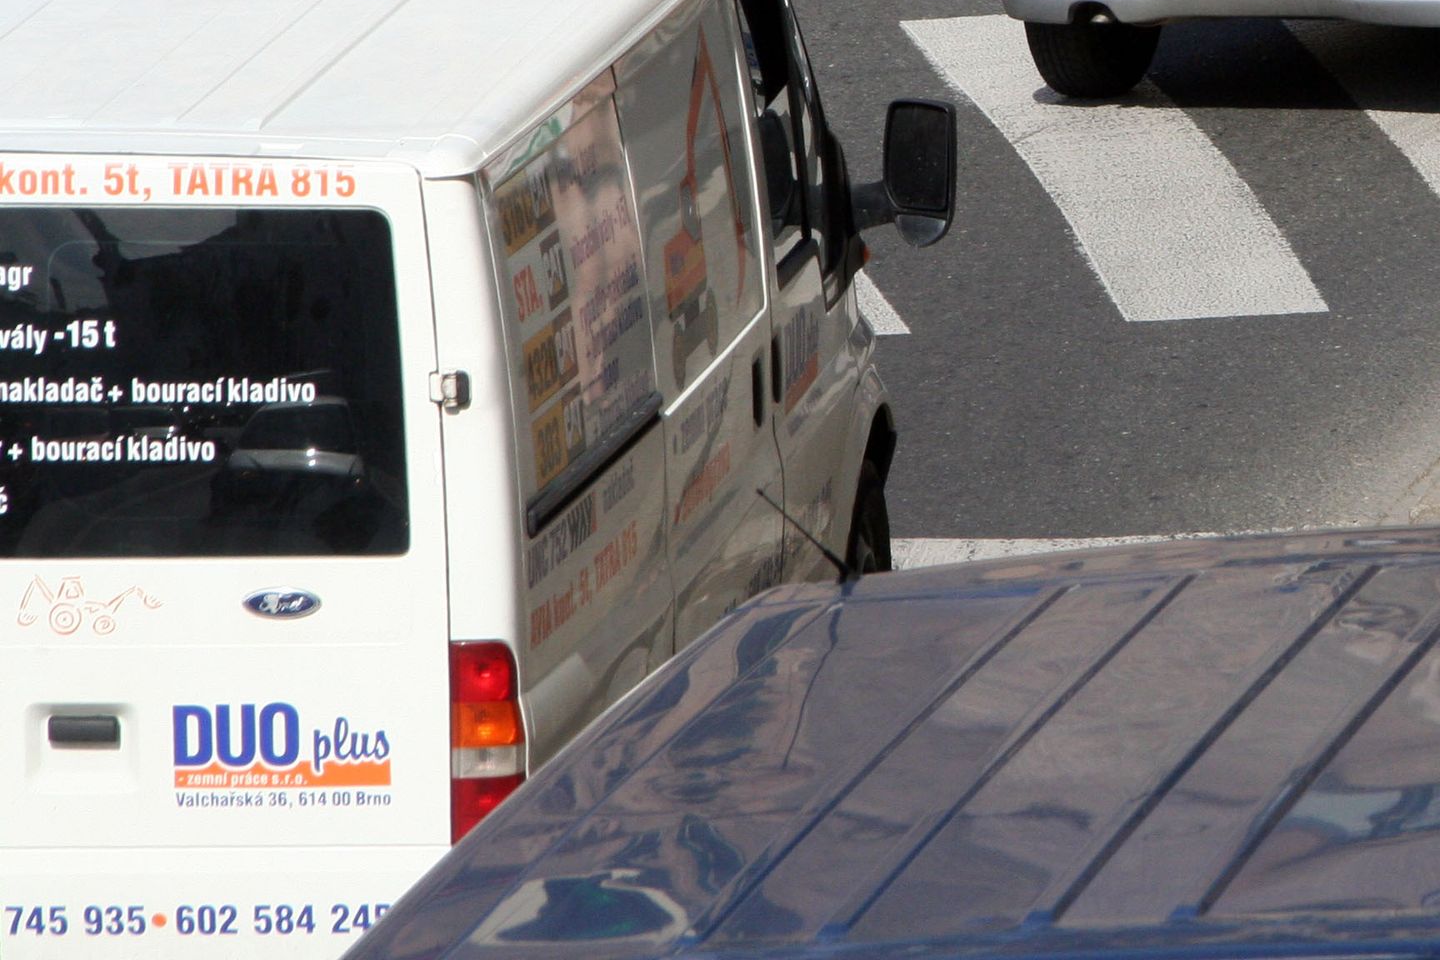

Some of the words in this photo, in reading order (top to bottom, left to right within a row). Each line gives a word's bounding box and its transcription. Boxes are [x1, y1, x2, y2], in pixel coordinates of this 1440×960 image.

[104, 163, 151, 201] 5t,
[168, 163, 278, 197] TATRA
[292, 164, 355, 197] 815
[132, 377, 222, 403] bourací
[228, 377, 315, 403] kladivo
[31, 435, 122, 461] bourací
[127, 435, 215, 461] kladivo
[173, 702, 299, 767] DUO
[313, 717, 390, 772] plus
[187, 771, 228, 786] zemní
[230, 771, 268, 788] práce
[271, 772, 308, 786] s.r.o.
[176, 791, 263, 808] Valchařská
[268, 792, 294, 809] 36,
[299, 791, 327, 807] 614
[332, 791, 351, 807] 00
[356, 791, 392, 807] Brno
[5, 905, 68, 936] 745
[83, 905, 147, 936] 935
[175, 904, 238, 935] 602
[253, 904, 316, 935] 584
